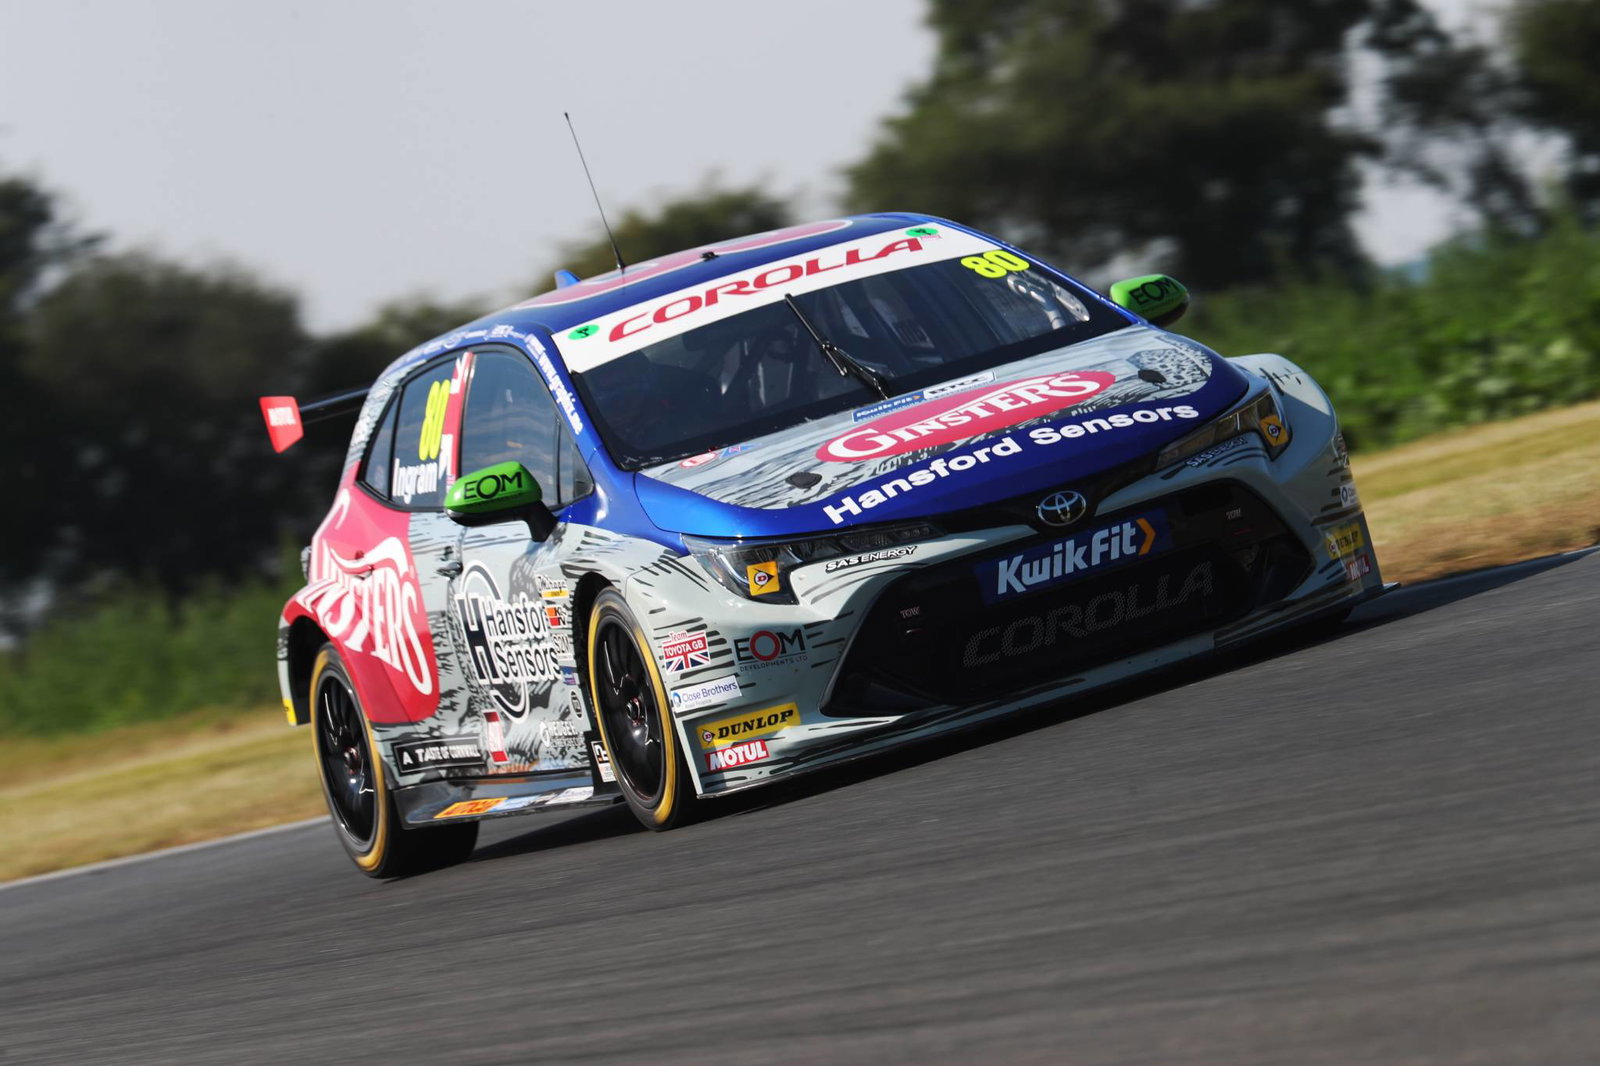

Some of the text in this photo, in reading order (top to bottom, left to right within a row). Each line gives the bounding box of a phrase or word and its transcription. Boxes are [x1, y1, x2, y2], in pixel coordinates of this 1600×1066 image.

[960, 249, 1030, 279] 80
[608, 236, 923, 343] COROLLA
[1128, 279, 1180, 306] EOM
[419, 379, 451, 461] 80
[827, 373, 1101, 458] GINSTERS
[822, 404, 1200, 525] Hansford Sensors
[392, 458, 437, 504] Ingram
[463, 471, 523, 500] EOM
[962, 560, 1216, 668] COROLLA
[664, 639, 704, 658] TOYOTA GB
[670, 631, 688, 643] Team
[733, 628, 806, 663] EOM
[493, 639, 562, 681] Sensors
[701, 681, 738, 699] Brothers
[717, 709, 794, 740] DUNLOP
[402, 751, 414, 765] A
[709, 740, 767, 771] MOTUL
